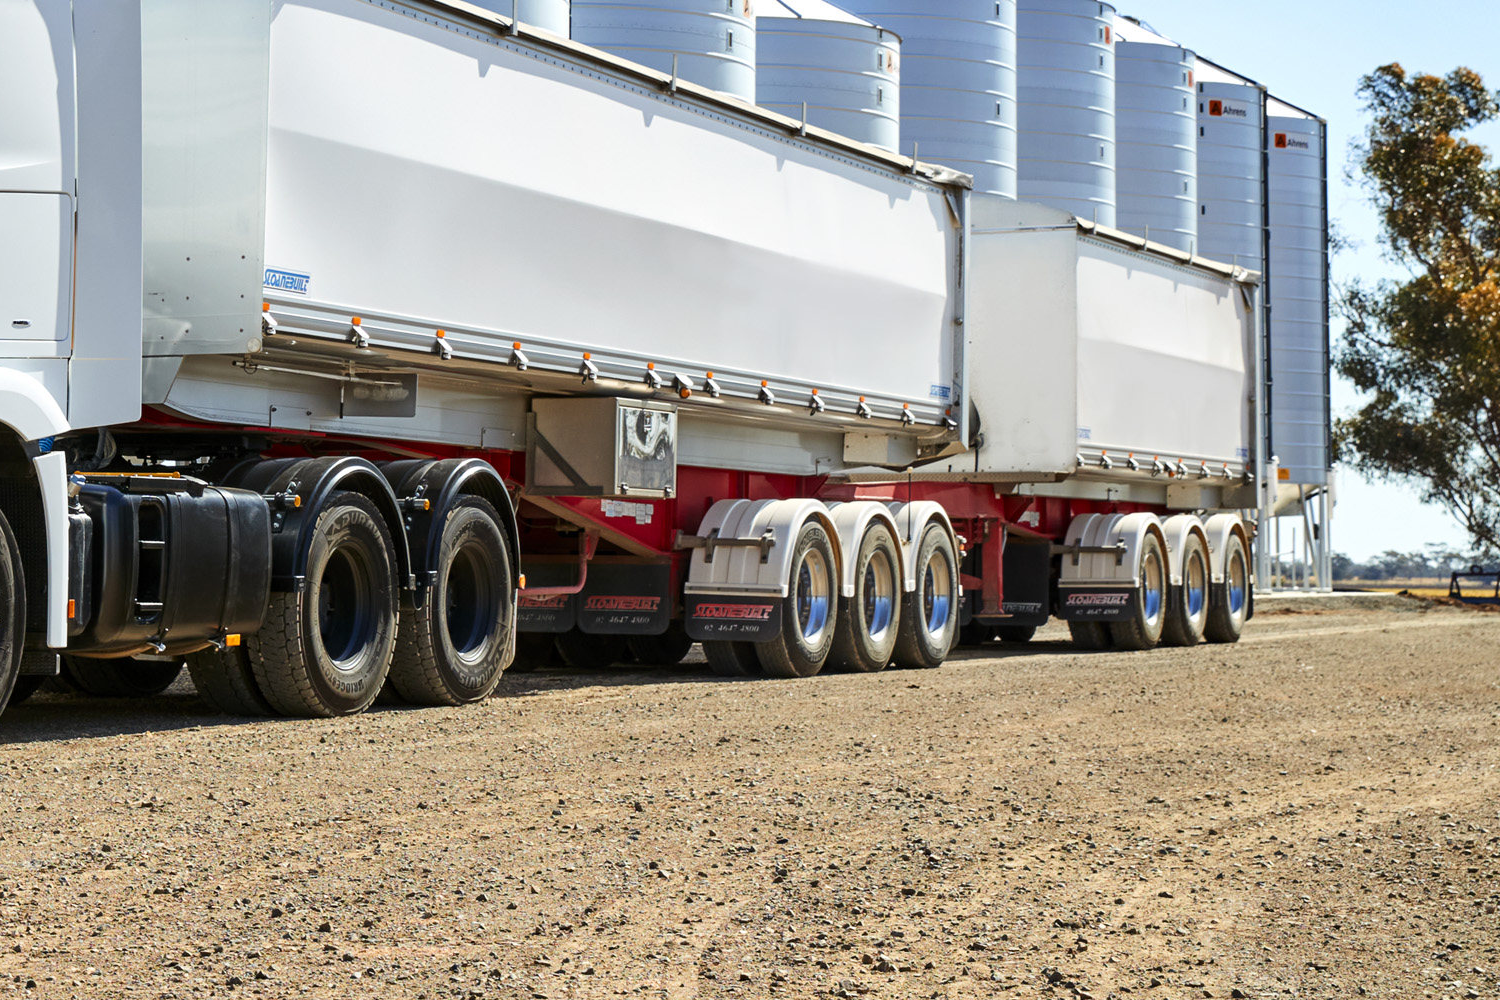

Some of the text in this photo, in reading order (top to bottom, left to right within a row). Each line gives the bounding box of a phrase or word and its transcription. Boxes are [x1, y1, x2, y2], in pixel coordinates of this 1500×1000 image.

[1223, 106, 1247, 117] Ahrens
[1287, 138, 1308, 150] Ahrens
[609, 616, 628, 624] 4647
[718, 624, 738, 632] 4647
